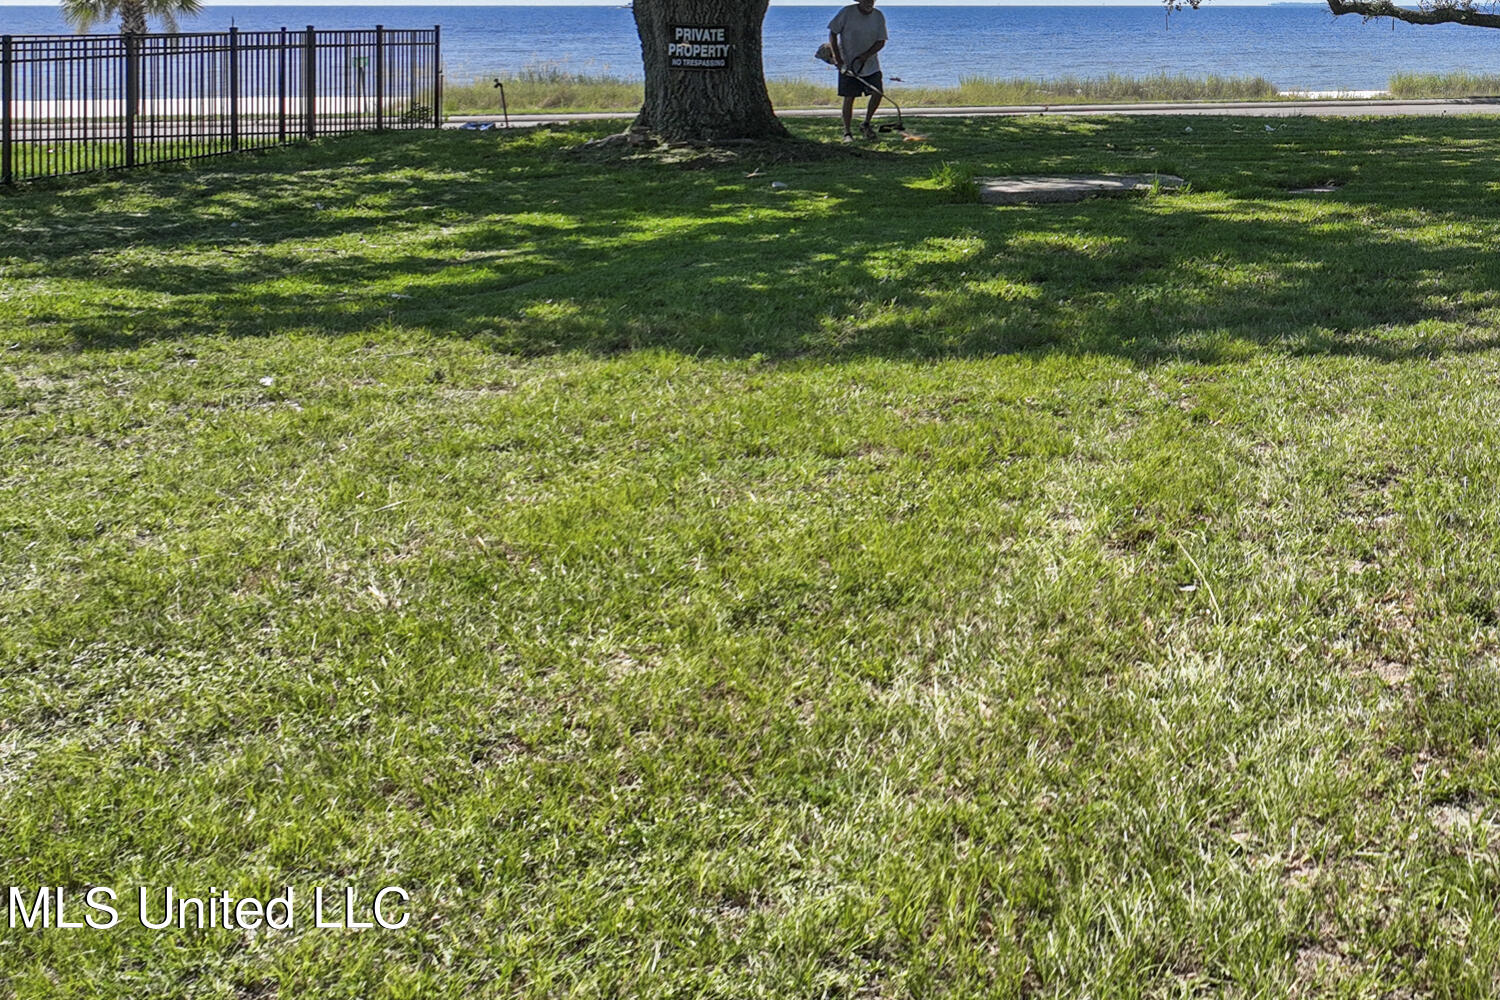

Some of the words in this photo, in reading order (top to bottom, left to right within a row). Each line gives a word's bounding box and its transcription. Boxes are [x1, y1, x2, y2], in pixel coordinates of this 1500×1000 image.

[675, 27, 725, 41] PRIVATE
[668, 43, 730, 57] PROPERTY
[671, 58, 682, 66] NO
[683, 59, 726, 67] TRESPASSING
